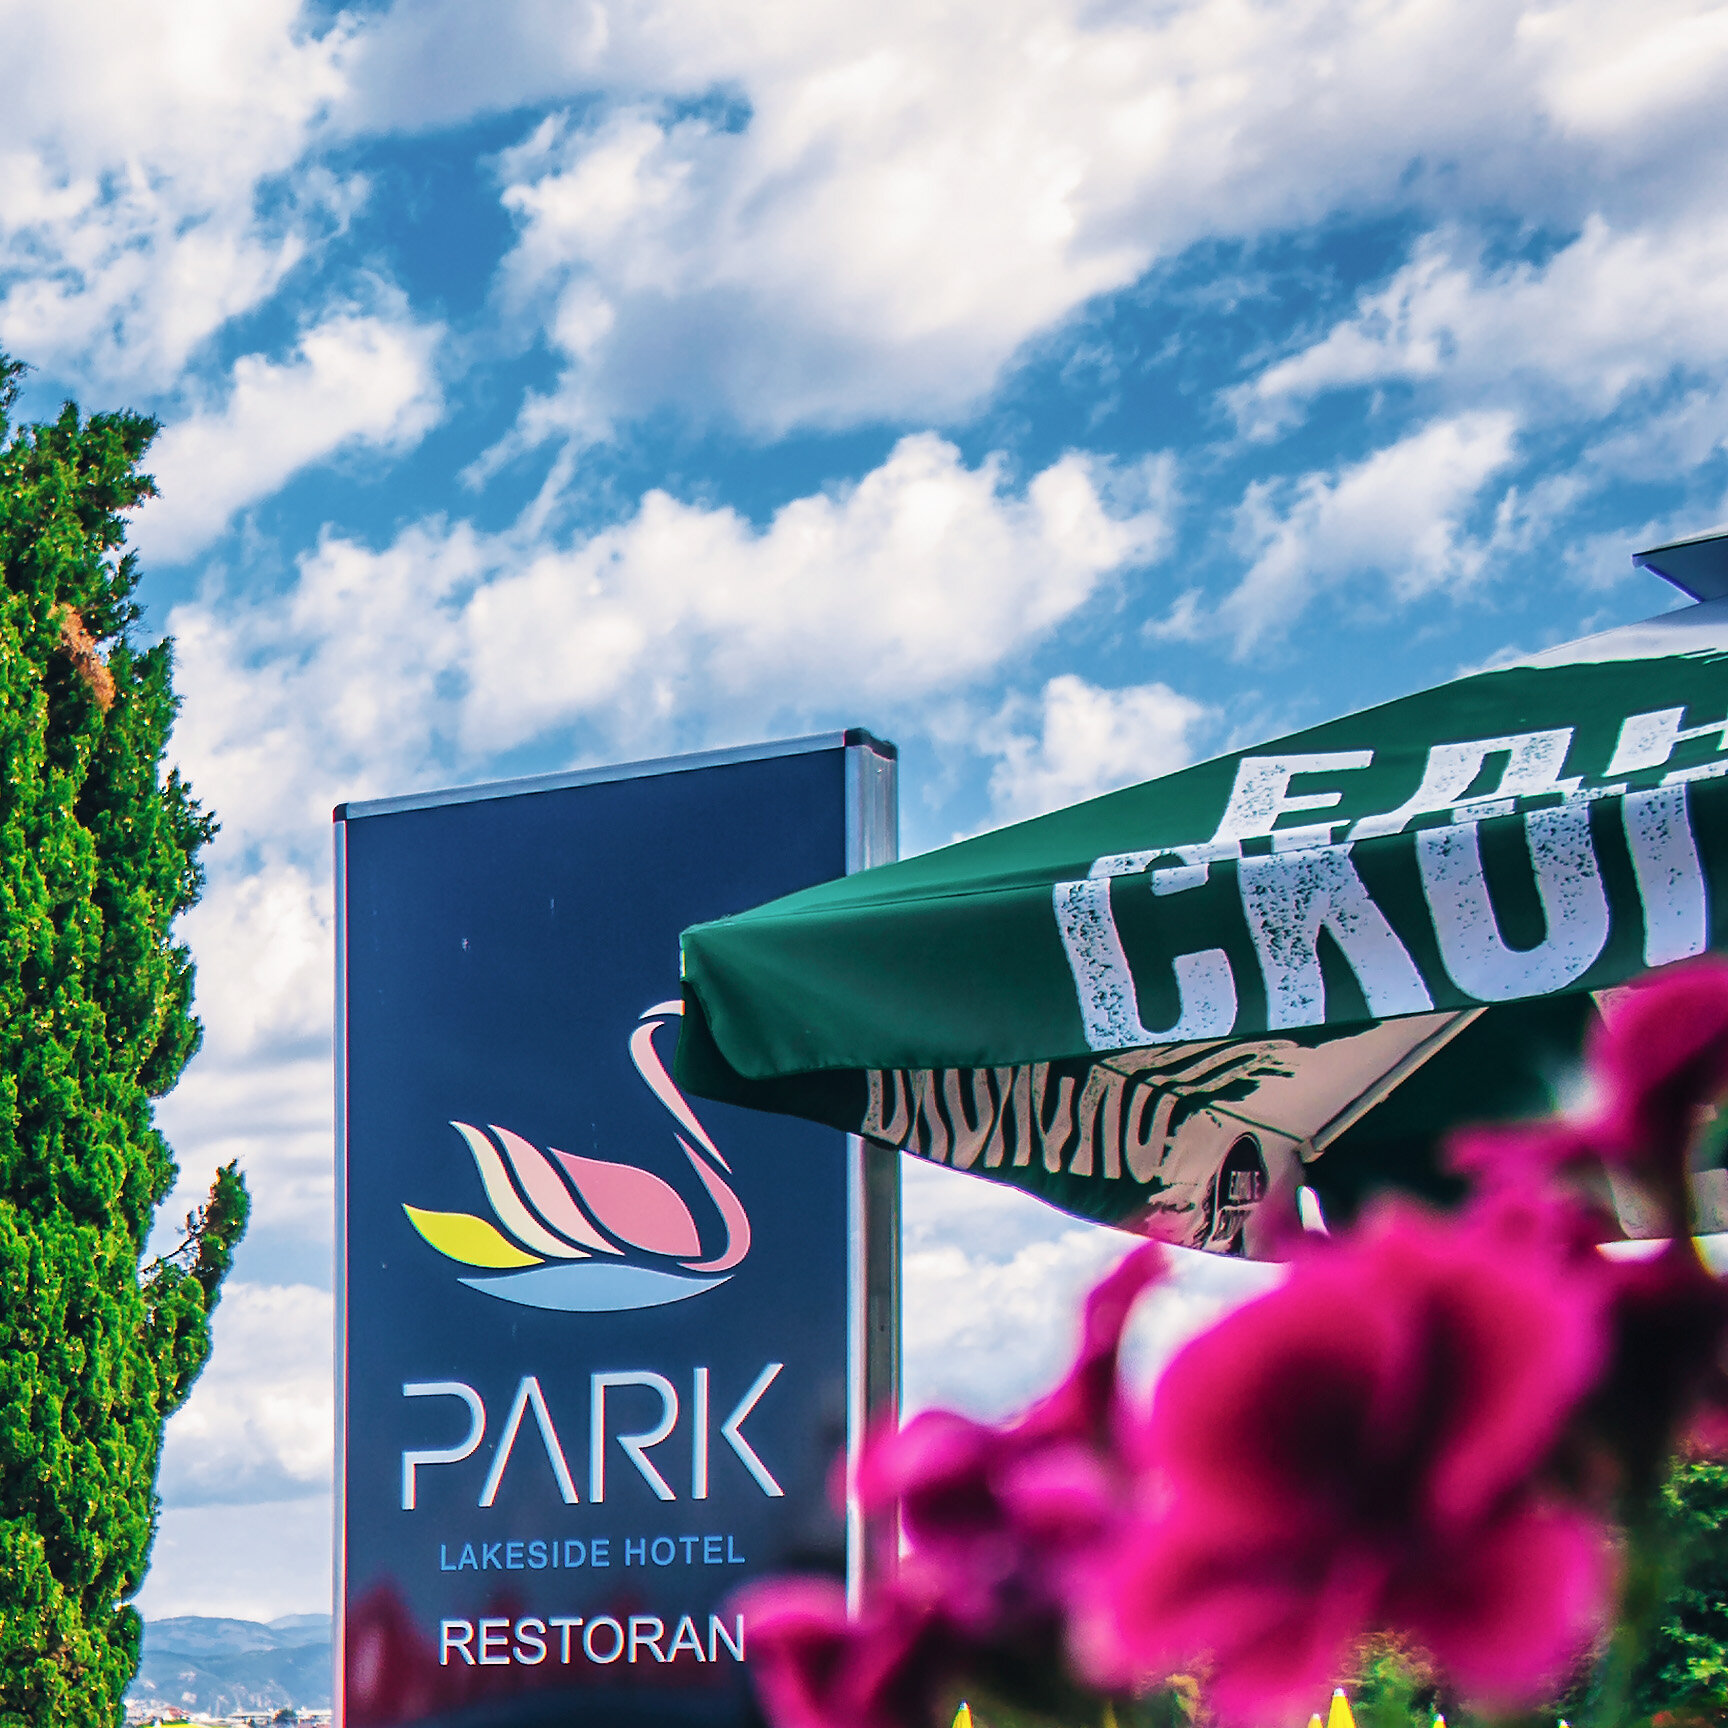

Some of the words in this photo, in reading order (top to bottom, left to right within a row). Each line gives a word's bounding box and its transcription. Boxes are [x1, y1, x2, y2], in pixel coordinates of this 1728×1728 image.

[401, 1362, 786, 1511] PARK
[440, 1538, 611, 1572] LAKESIDE
[623, 1535, 746, 1568] HOTEL
[439, 1612, 746, 1666] RESTORAN
